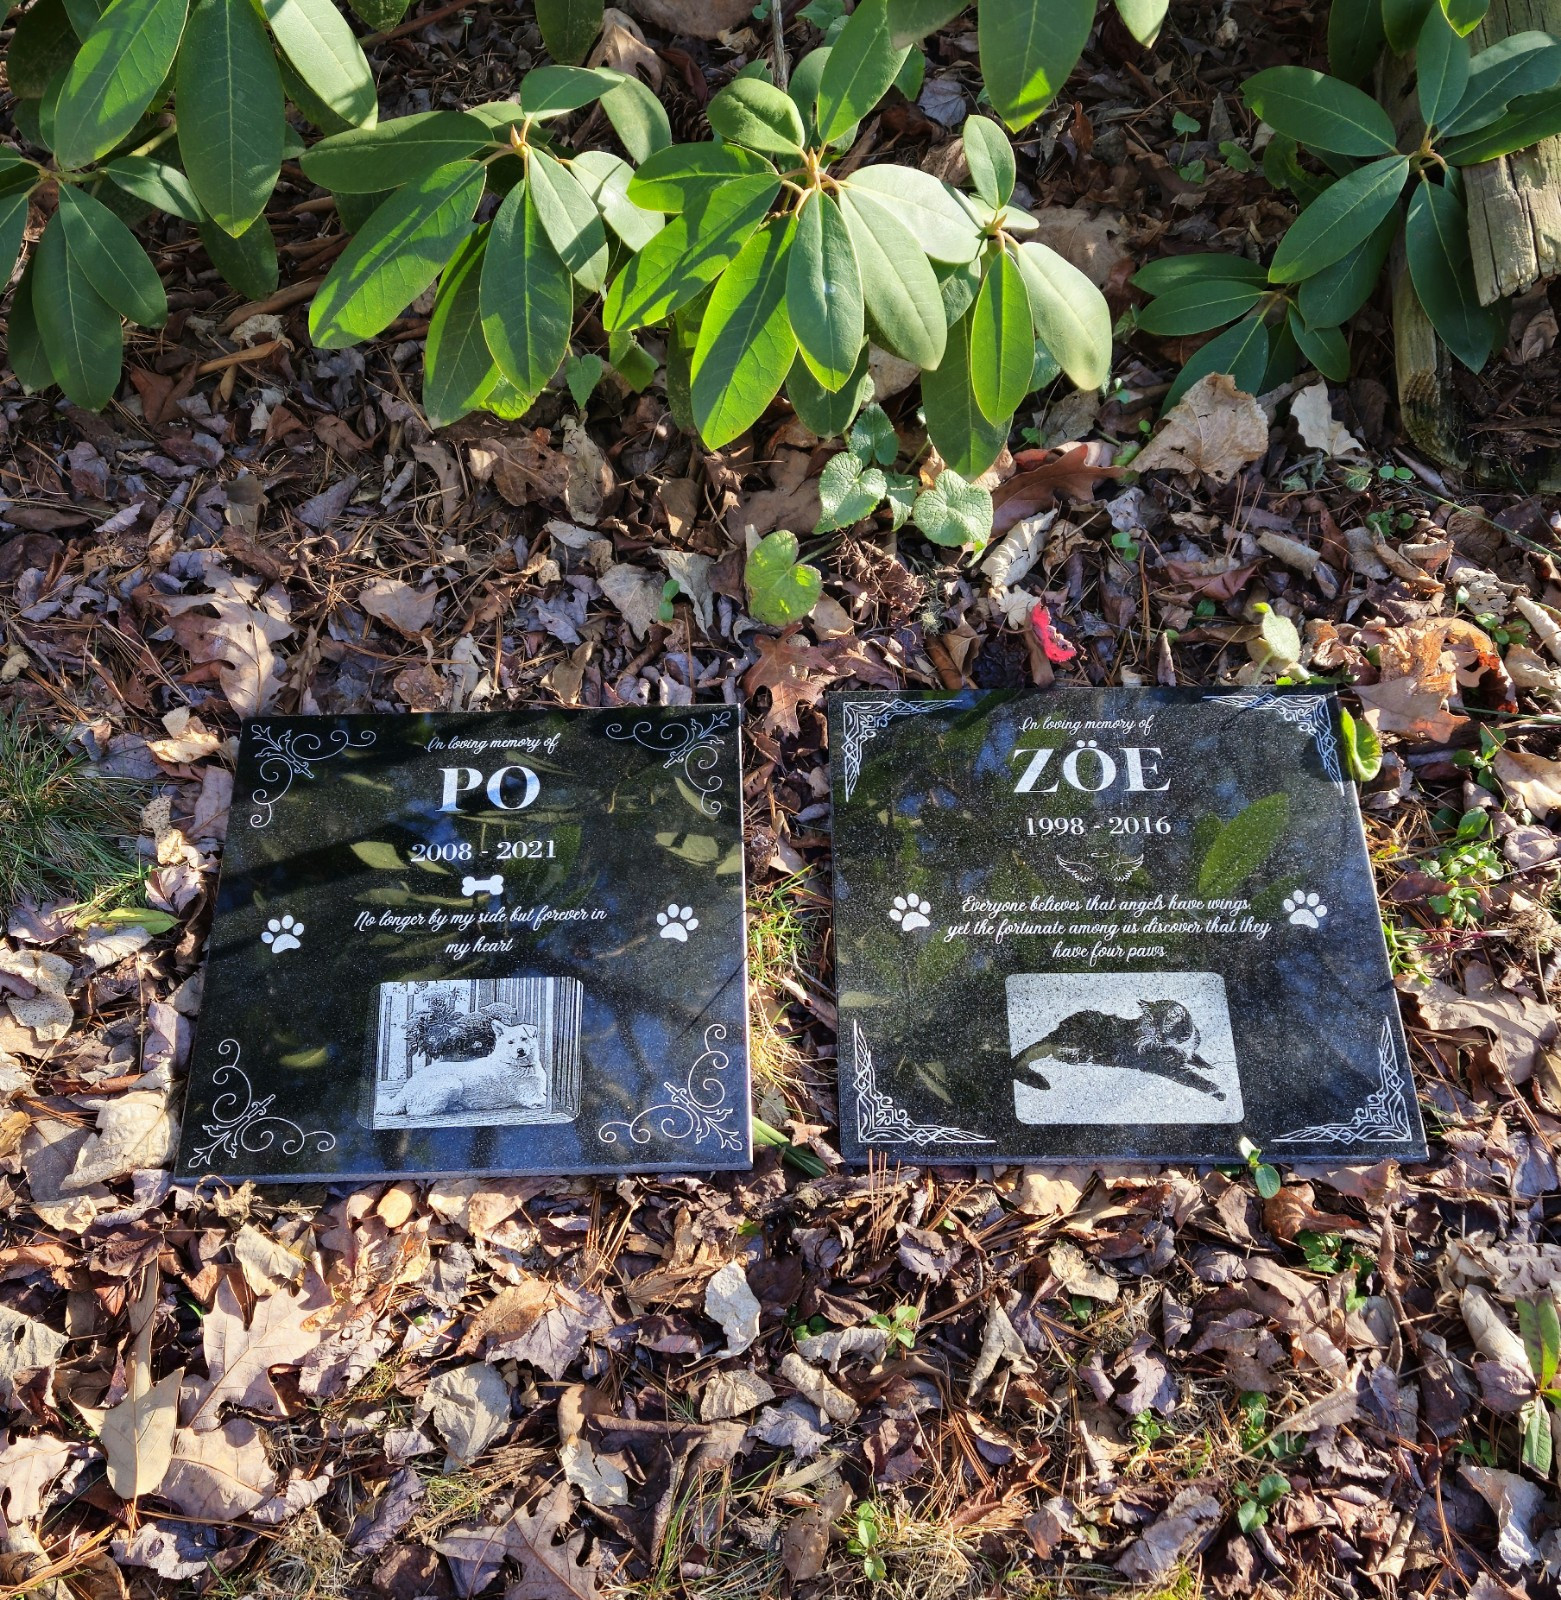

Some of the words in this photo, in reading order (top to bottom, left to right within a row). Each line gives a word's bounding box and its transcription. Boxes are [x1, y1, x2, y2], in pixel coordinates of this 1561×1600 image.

[1019, 717, 1039, 732] In
[1042, 716, 1082, 735] loving
[1085, 719, 1135, 734] memory
[1138, 715, 1155, 735] of
[424, 737, 446, 752] In
[447, 736, 488, 754] loving
[489, 737, 540, 753] memory
[543, 733, 561, 754] of
[1012, 740, 1171, 793] ZÖE
[435, 765, 541, 812] PO
[1026, 817, 1085, 836] 1998
[1108, 815, 1171, 834] 2016
[411, 843, 472, 862] 2008
[496, 840, 556, 860] 2021
[354, 911, 376, 932] No
[379, 910, 426, 933] longer
[428, 908, 448, 932] by
[450, 911, 476, 929] my
[478, 906, 507, 923] side
[509, 906, 534, 923] but
[532, 905, 588, 931] forever
[590, 907, 608, 920] in
[962, 896, 1027, 919] Everyone
[1030, 895, 1083, 912] believes
[1086, 895, 1117, 911] that
[1119, 894, 1165, 917] angels
[1168, 894, 1204, 910] have
[943, 921, 971, 943] yet
[973, 919, 996, 935] the
[995, 918, 1066, 944] fortunate
[1068, 922, 1121, 941] among
[1122, 923, 1140, 934] us
[1142, 917, 1203, 934] discover
[1205, 916, 1237, 933] that
[1239, 916, 1272, 940] they
[445, 943, 471, 960] my
[472, 936, 514, 953] heart
[1052, 941, 1089, 958] have
[1089, 940, 1125, 967] four
